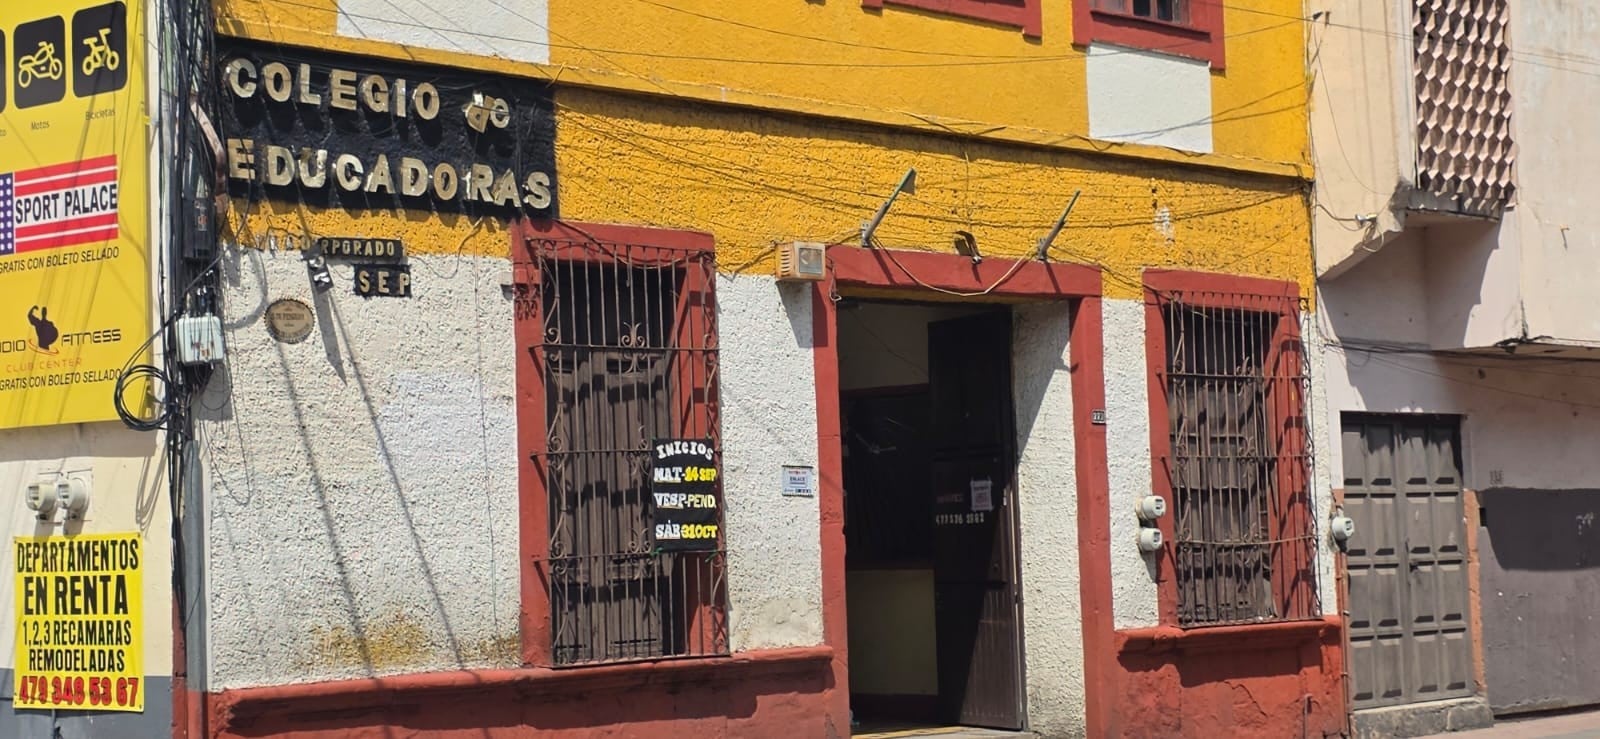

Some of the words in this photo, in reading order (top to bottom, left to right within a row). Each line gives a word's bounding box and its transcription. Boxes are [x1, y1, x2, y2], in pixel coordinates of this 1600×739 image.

[226, 58, 440, 120] COLEGIO
[464, 90, 511, 133] de
[31, 121, 50, 130] Motos
[85, 109, 116, 120] Bicicletas
[227, 138, 552, 209] EDUCADORAS
[15, 193, 60, 224] SPORT
[64, 183, 118, 211] PALACE
[27, 257, 45, 270] CON
[46, 251, 80, 268] BOLETO
[81, 246, 120, 263] SELLADO
[0, 339, 26, 353] DIO
[61, 328, 122, 347] FITNESS
[6, 361, 34, 374] CLUB
[39, 357, 82, 371] CENTER
[0, 377, 28, 391] GRATIS
[29, 374, 46, 388] CON
[47, 371, 81, 386] BOLETO
[82, 368, 121, 383] SELLADO
[656, 440, 714, 461] INICIOS
[699, 468, 717, 482] SEP
[17, 539, 139, 573] DEPARTAMENTOS
[24, 576, 48, 615] EN
[54, 575, 128, 615] RENTA
[23, 620, 51, 647] 1,2,3
[53, 620, 132, 646] RECAMARAS
[29, 649, 125, 673] REMODELADAS
[19, 676, 48, 704] 479
[51, 676, 85, 705] 348
[89, 677, 113, 706] 53
[116, 677, 139, 707] 67
